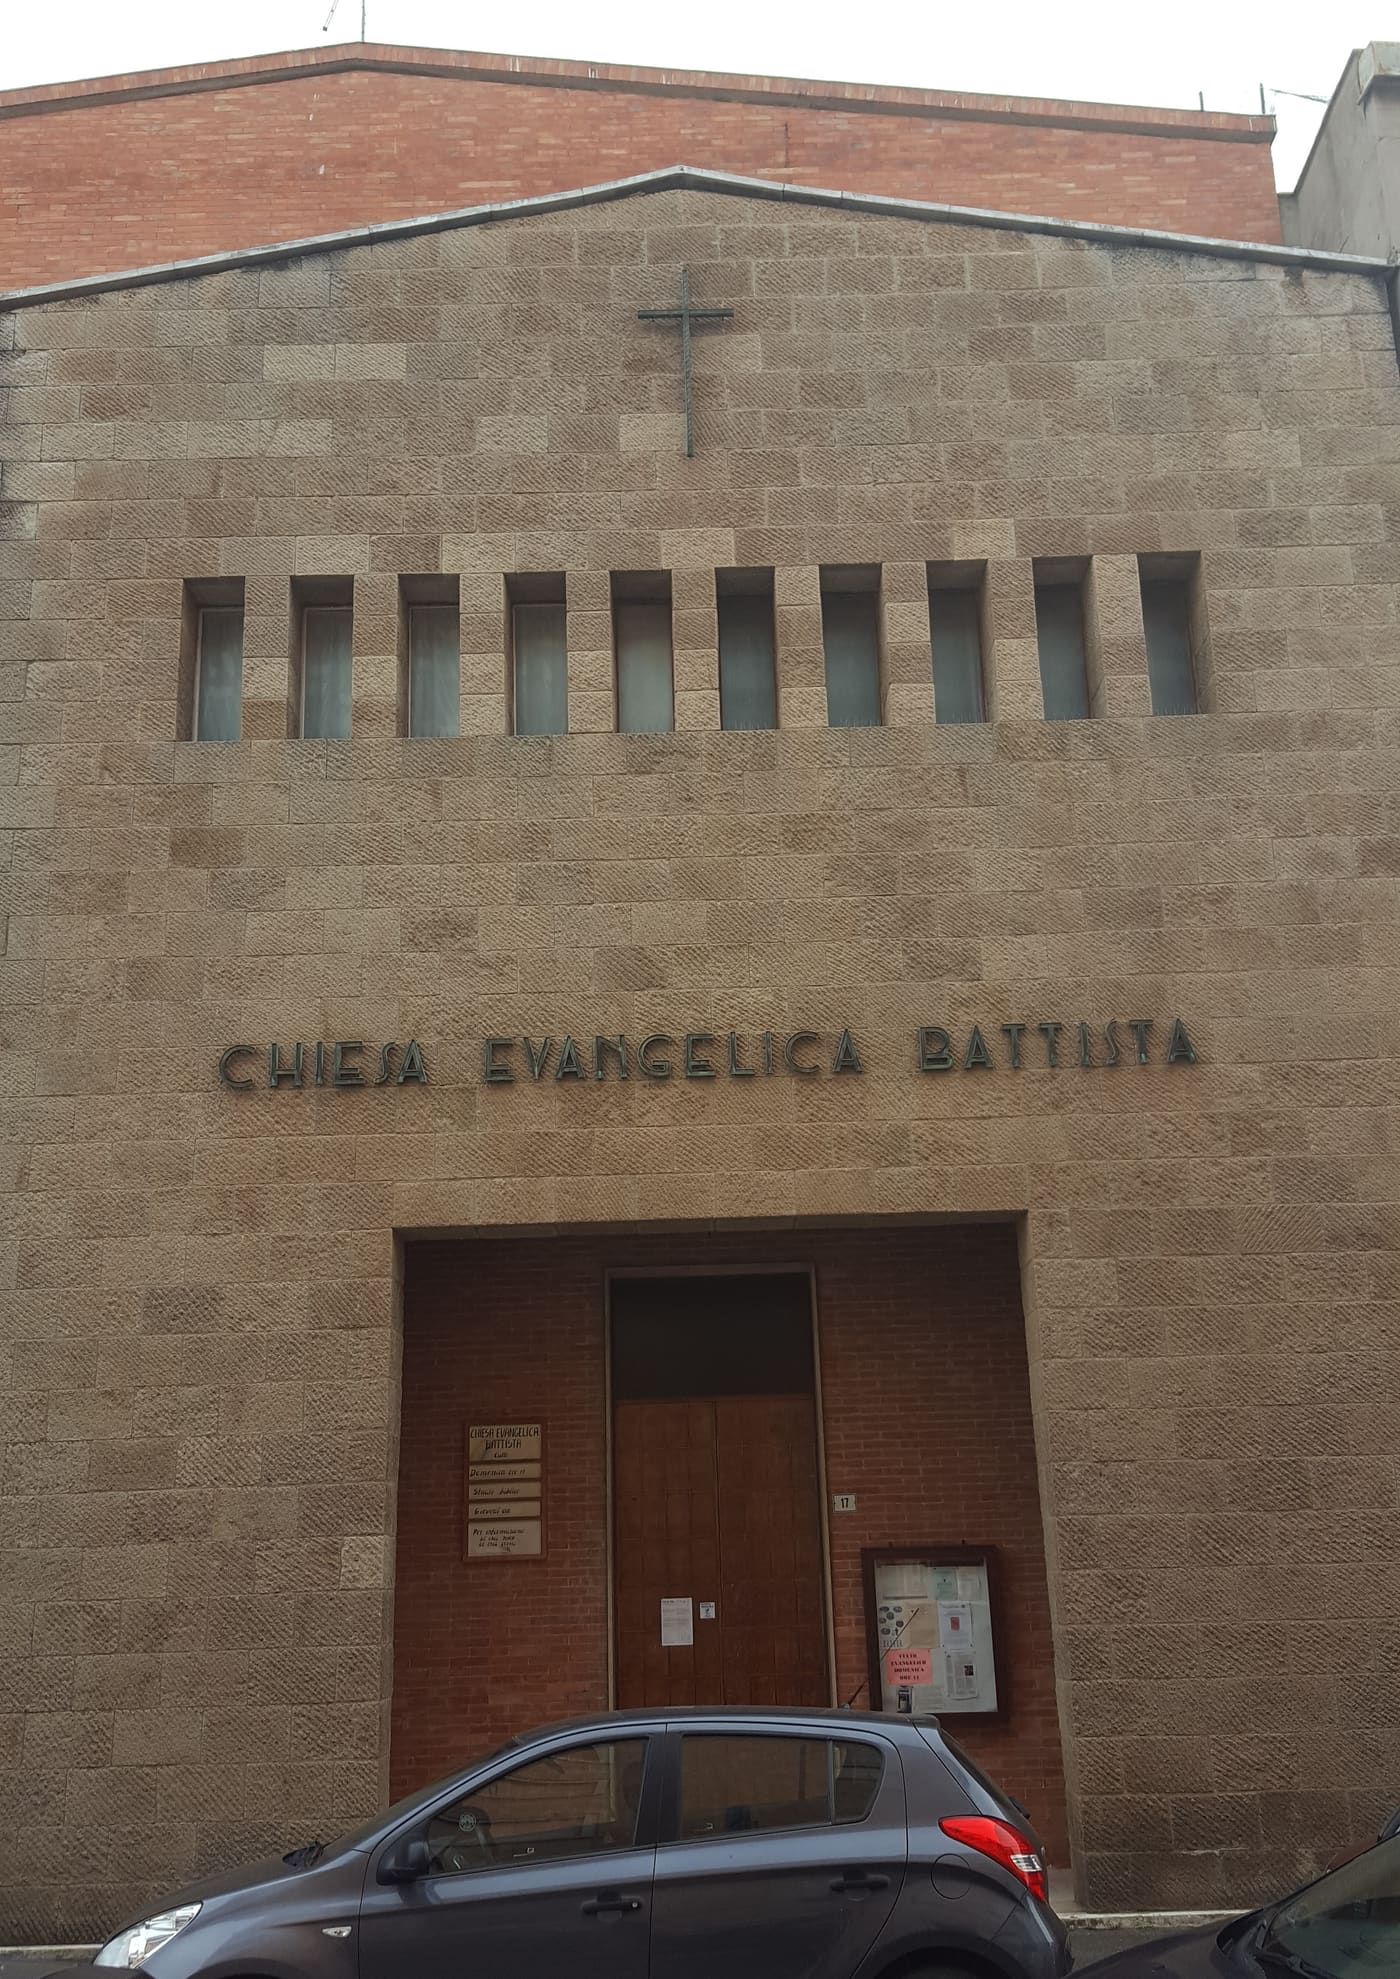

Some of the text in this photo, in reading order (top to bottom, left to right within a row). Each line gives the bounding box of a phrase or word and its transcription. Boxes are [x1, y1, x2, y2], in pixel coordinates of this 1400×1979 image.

[219, 1017, 1198, 1088] CHIESA EVANGELICA BATTISTA
[470, 1426, 540, 1439] CHIESA EVANGELICA
[485, 1439, 522, 1450] BATTISTA
[840, 1497, 849, 1509] 17
